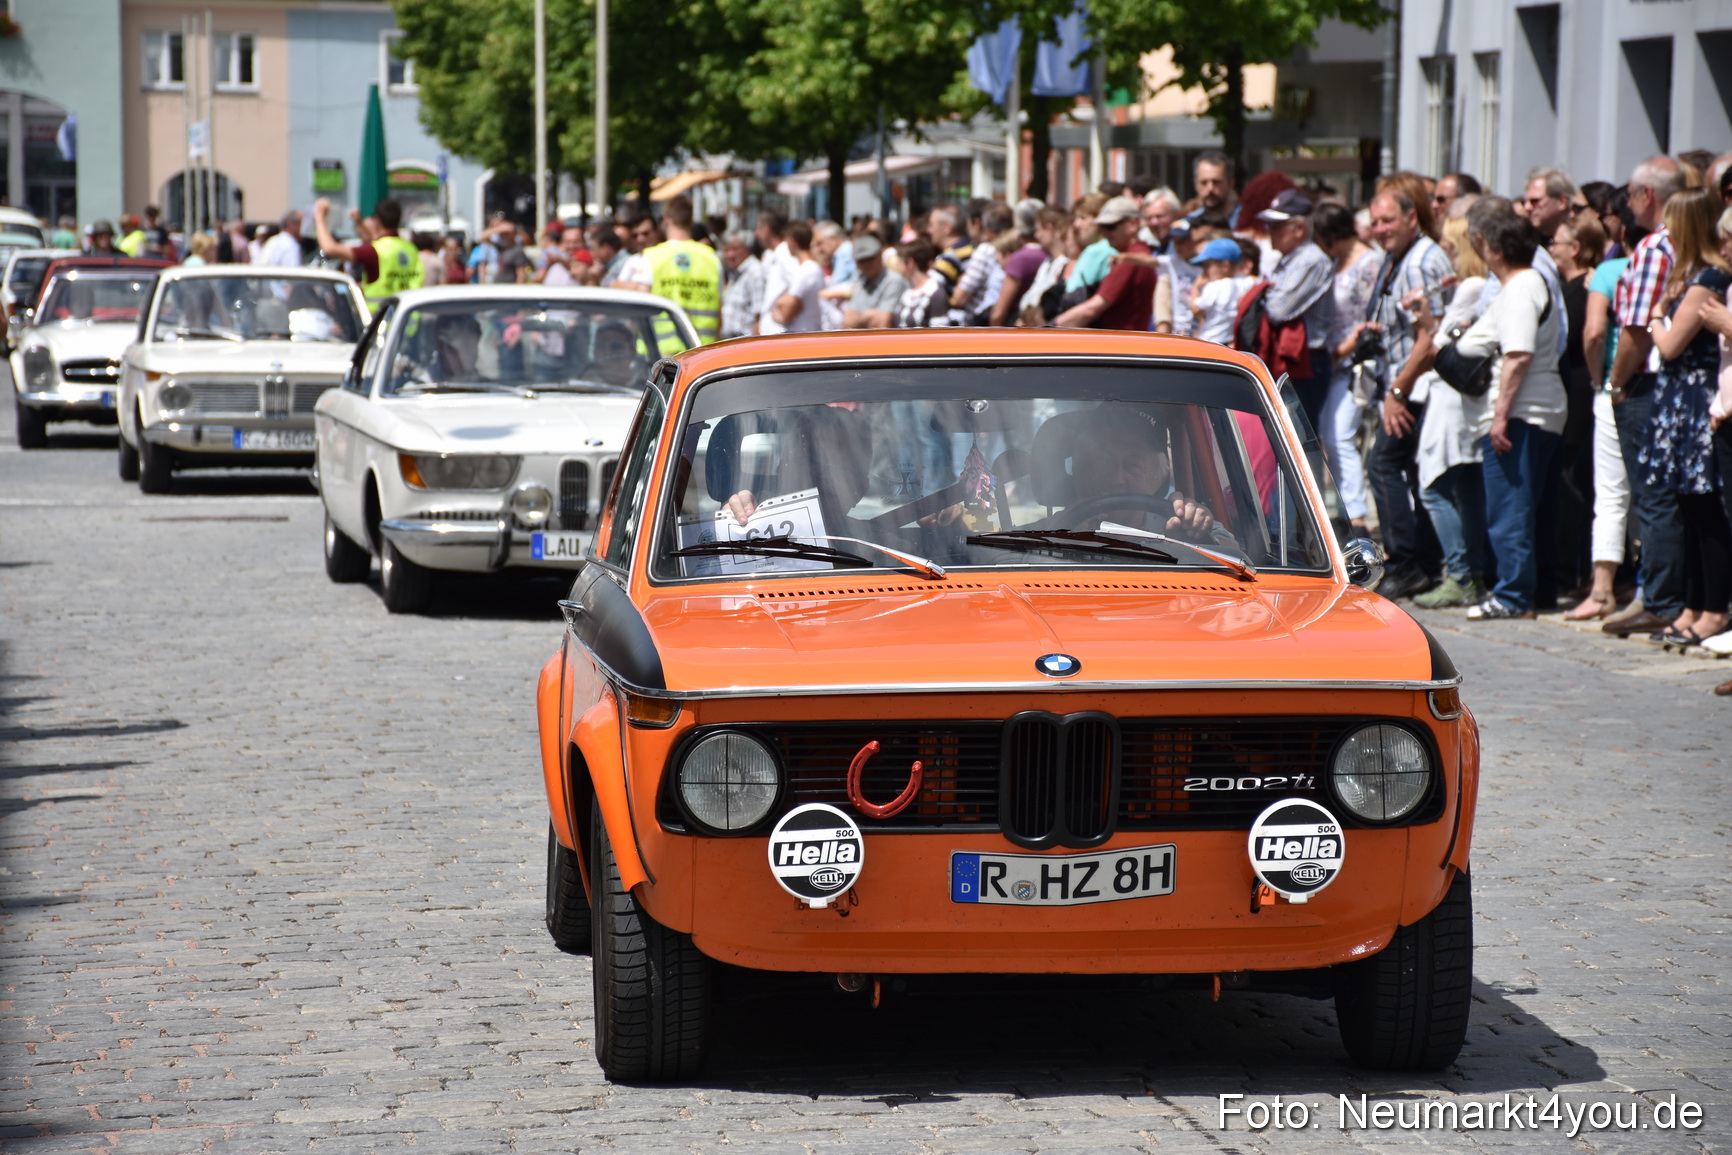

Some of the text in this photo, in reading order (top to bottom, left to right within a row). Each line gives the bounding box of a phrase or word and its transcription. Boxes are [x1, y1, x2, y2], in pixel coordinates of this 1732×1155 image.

[544, 537, 580, 556] LAU
[835, 829, 855, 838] 500
[1317, 825, 1336, 833] 500
[778, 841, 856, 865] Hella
[1260, 836, 1337, 860] Hella
[812, 873, 845, 882] HELLA
[980, 852, 1171, 899] R HZ 8H
[1293, 868, 1326, 878] HELLA
[961, 882, 971, 894] D
